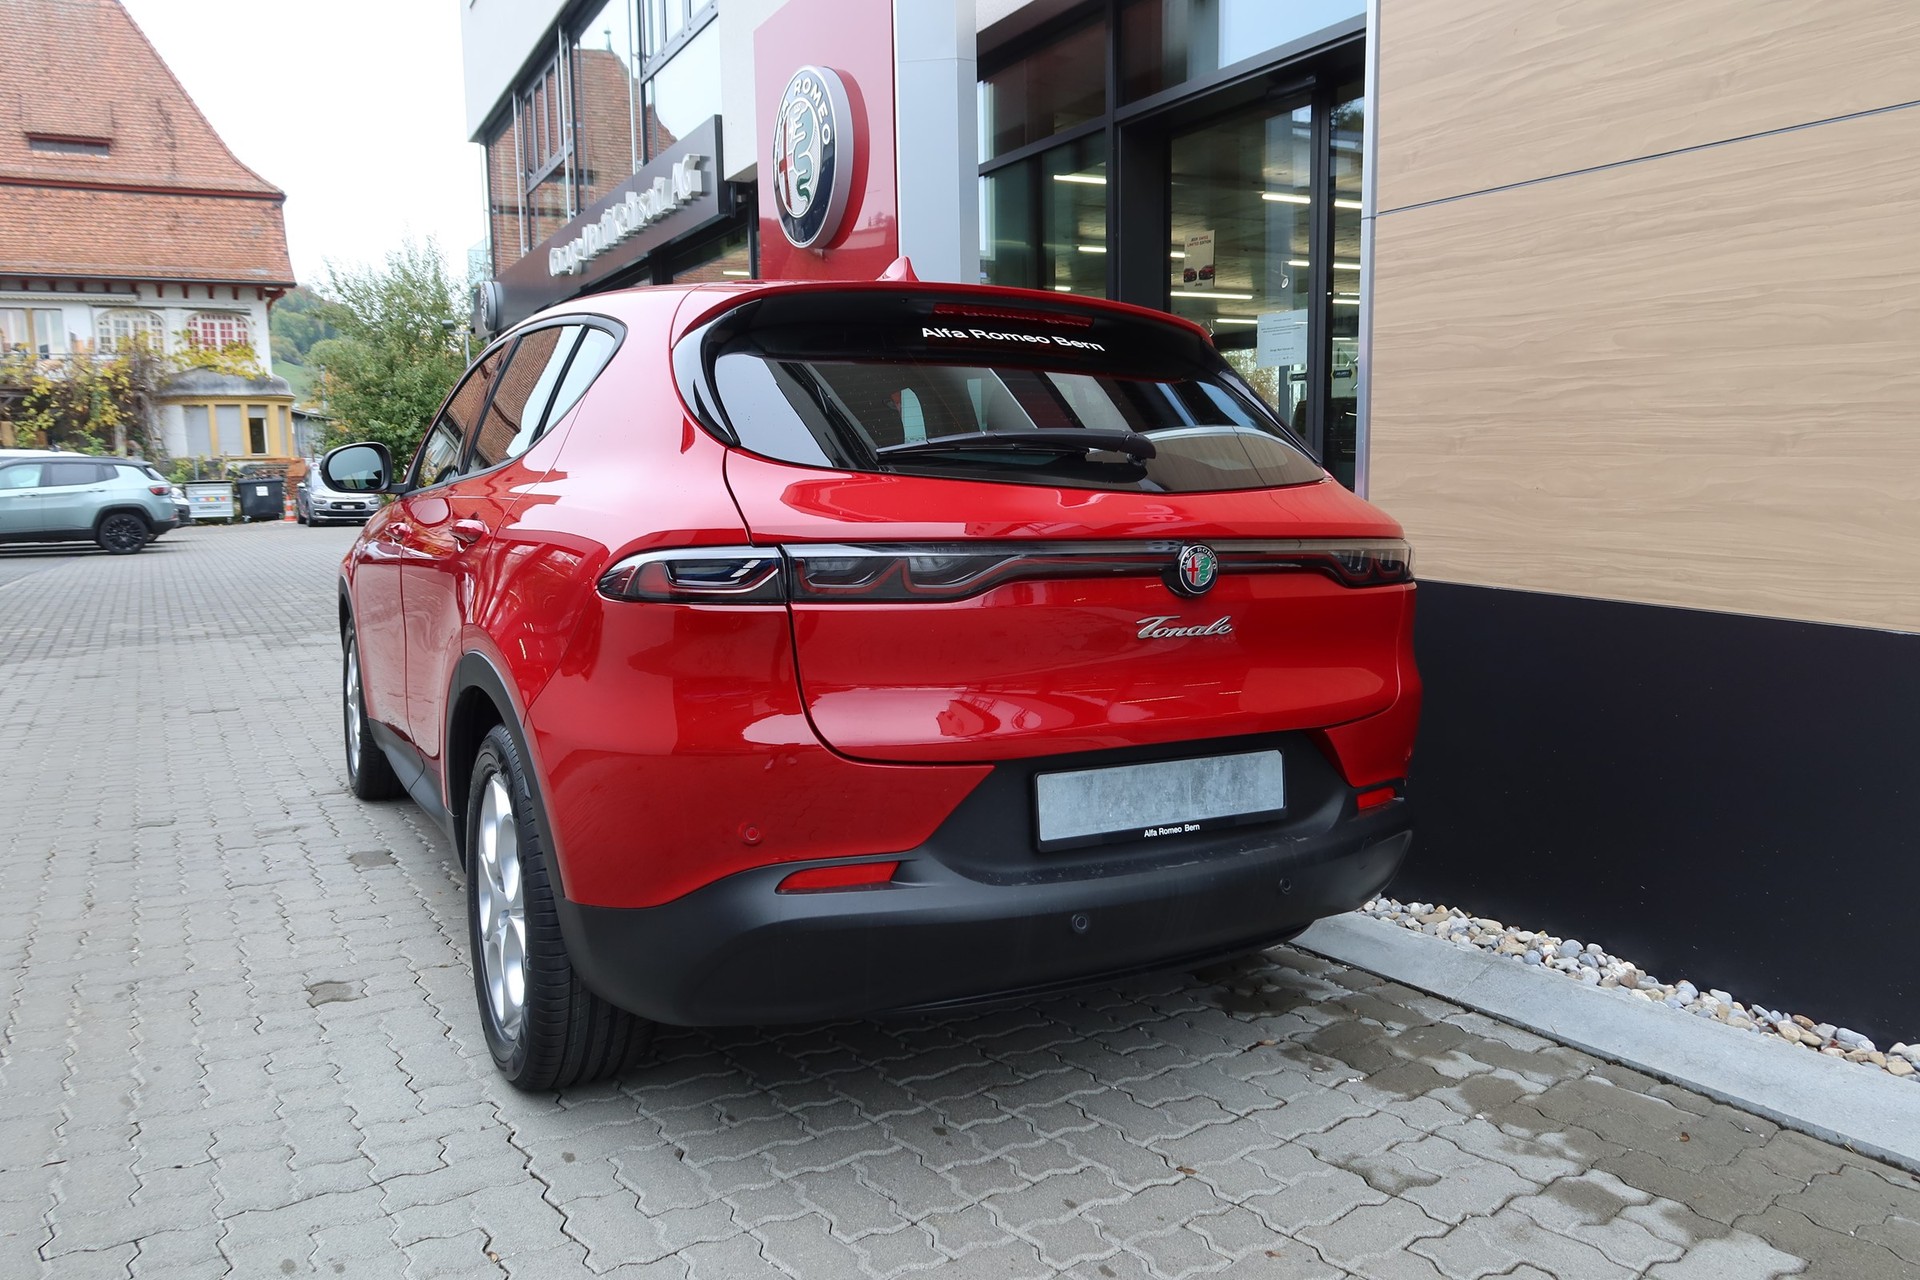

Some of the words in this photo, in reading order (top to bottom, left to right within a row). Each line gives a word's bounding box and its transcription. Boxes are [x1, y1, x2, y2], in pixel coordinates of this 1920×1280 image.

[793, 78, 831, 145] ROMEO
[672, 153, 702, 204] AG
[921, 327, 968, 339] Alfa
[968, 328, 1050, 344] Romeo
[1051, 335, 1106, 352] Bern
[1181, 550, 1195, 570] ALFA
[1197, 547, 1217, 570] ROMEO
[1136, 615, 1233, 639] Tonale
[1144, 829, 1158, 838] Alfa
[1158, 826, 1182, 836] Romeo
[1184, 823, 1200, 832] Bern
